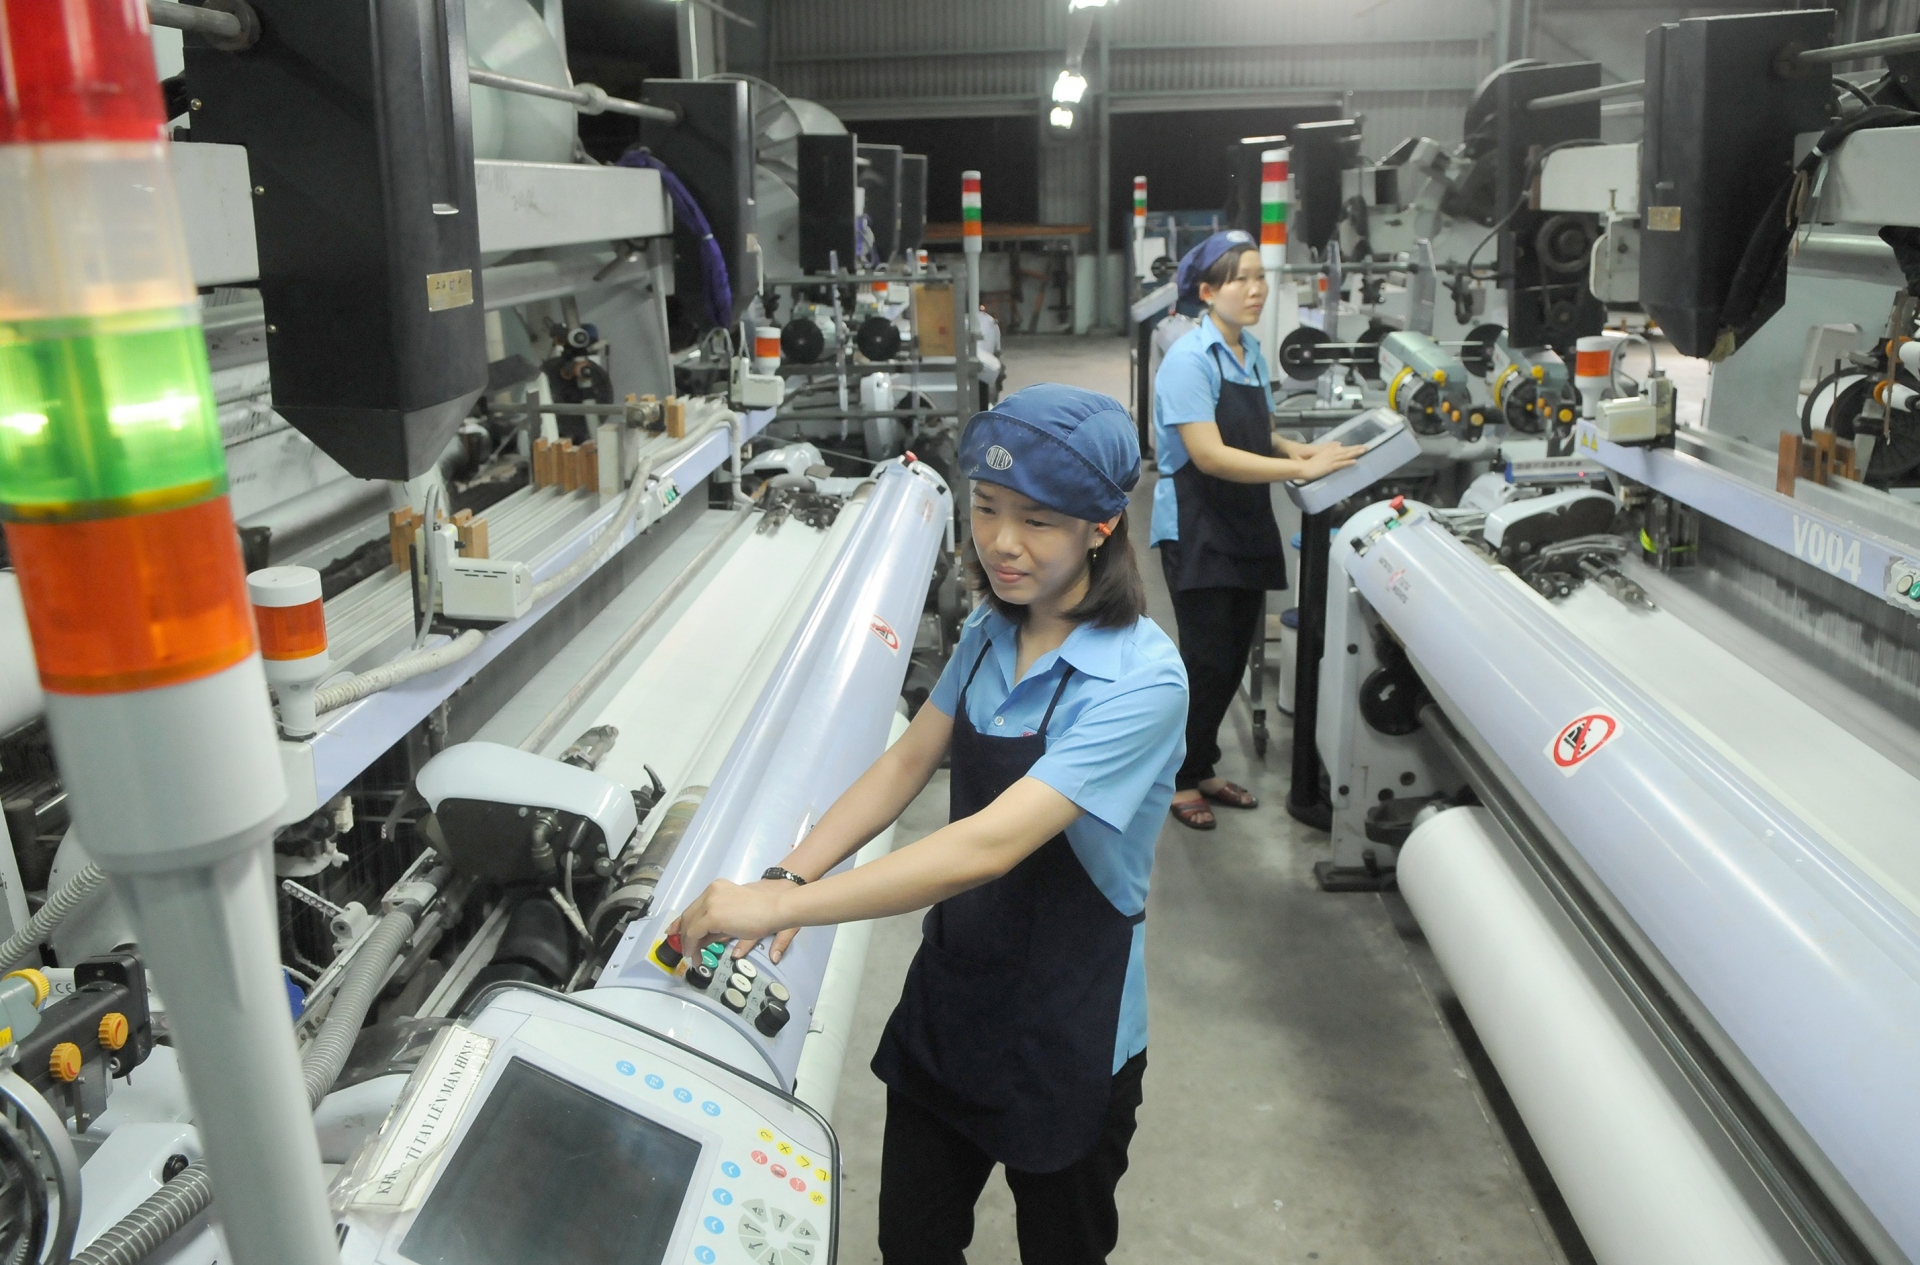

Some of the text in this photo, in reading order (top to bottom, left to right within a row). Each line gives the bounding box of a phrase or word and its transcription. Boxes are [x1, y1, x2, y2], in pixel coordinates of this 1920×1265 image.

[1792, 513, 1862, 584] V004
[621, 1063, 631, 1073] F1
[440, 1068, 462, 1097] MÀN
[649, 1076, 660, 1087] F2
[677, 1090, 688, 1100] F3
[428, 1097, 448, 1121] LÊN
[706, 1103, 717, 1114] F4
[413, 1121, 435, 1145] TAY
[405, 1146, 422, 1161] TÌ
